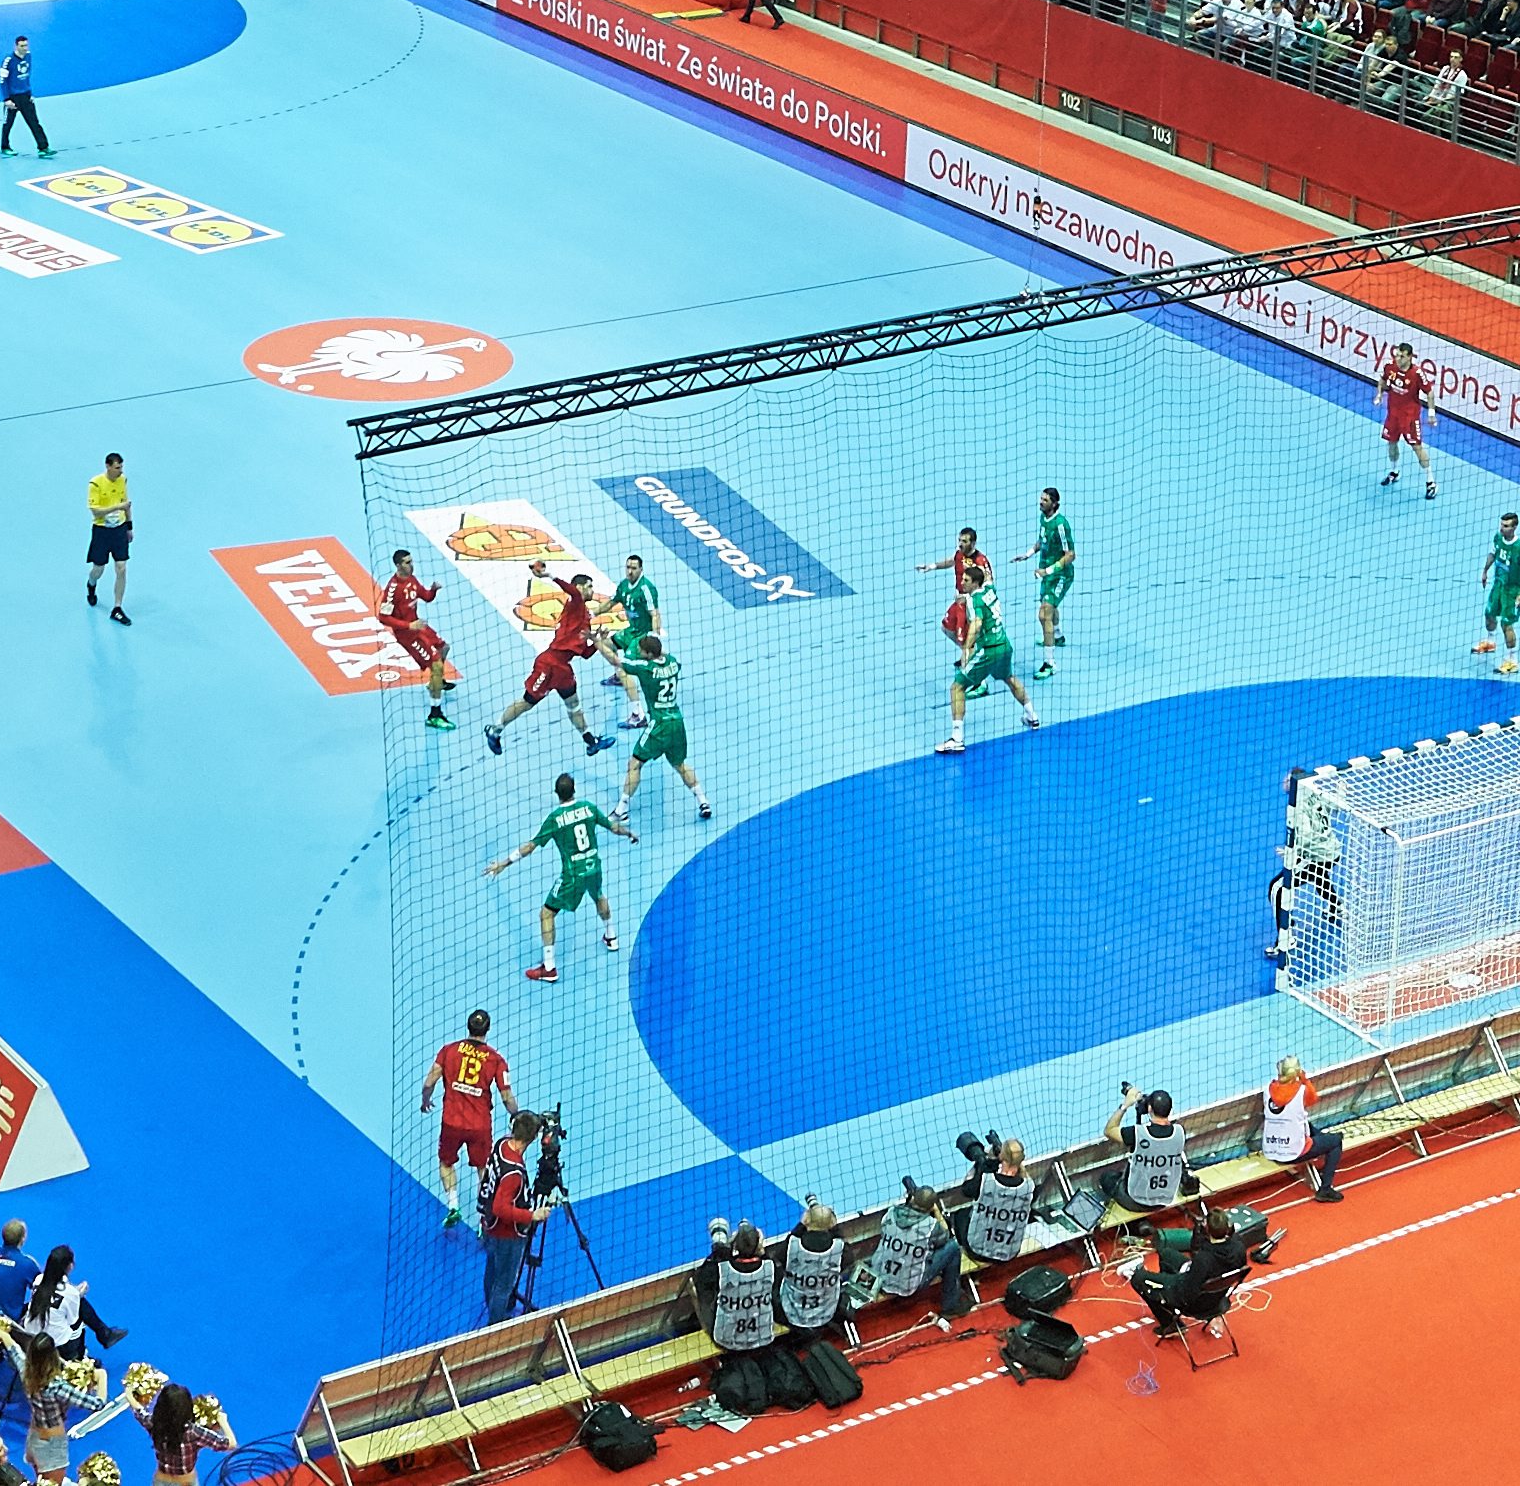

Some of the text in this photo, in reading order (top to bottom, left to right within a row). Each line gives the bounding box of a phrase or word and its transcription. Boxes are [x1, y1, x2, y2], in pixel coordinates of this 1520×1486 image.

[586, 12, 609, 41] na
[614, 18, 671, 68] świat.
[677, 44, 702, 81] Ze
[707, 56, 775, 111] świata
[781, 88, 809, 124] do
[815, 101, 886, 157] Polski.
[1061, 92, 1080, 111] 102
[1151, 125, 1171, 145] 103
[928, 149, 1008, 216] Odkryj
[635, 476, 765, 588] GRUNDFOS
[255, 549, 420, 679] VELUX
[658, 676, 677, 702] 23
[574, 823, 590, 852] 8
[458, 1056, 481, 1085] 13
[1149, 1175, 1168, 1190] 65
[977, 1203, 1028, 1223] PHOTO
[986, 1227, 1016, 1245] 157
[800, 1295, 820, 1309] 13
[736, 1318, 756, 1333] 84
